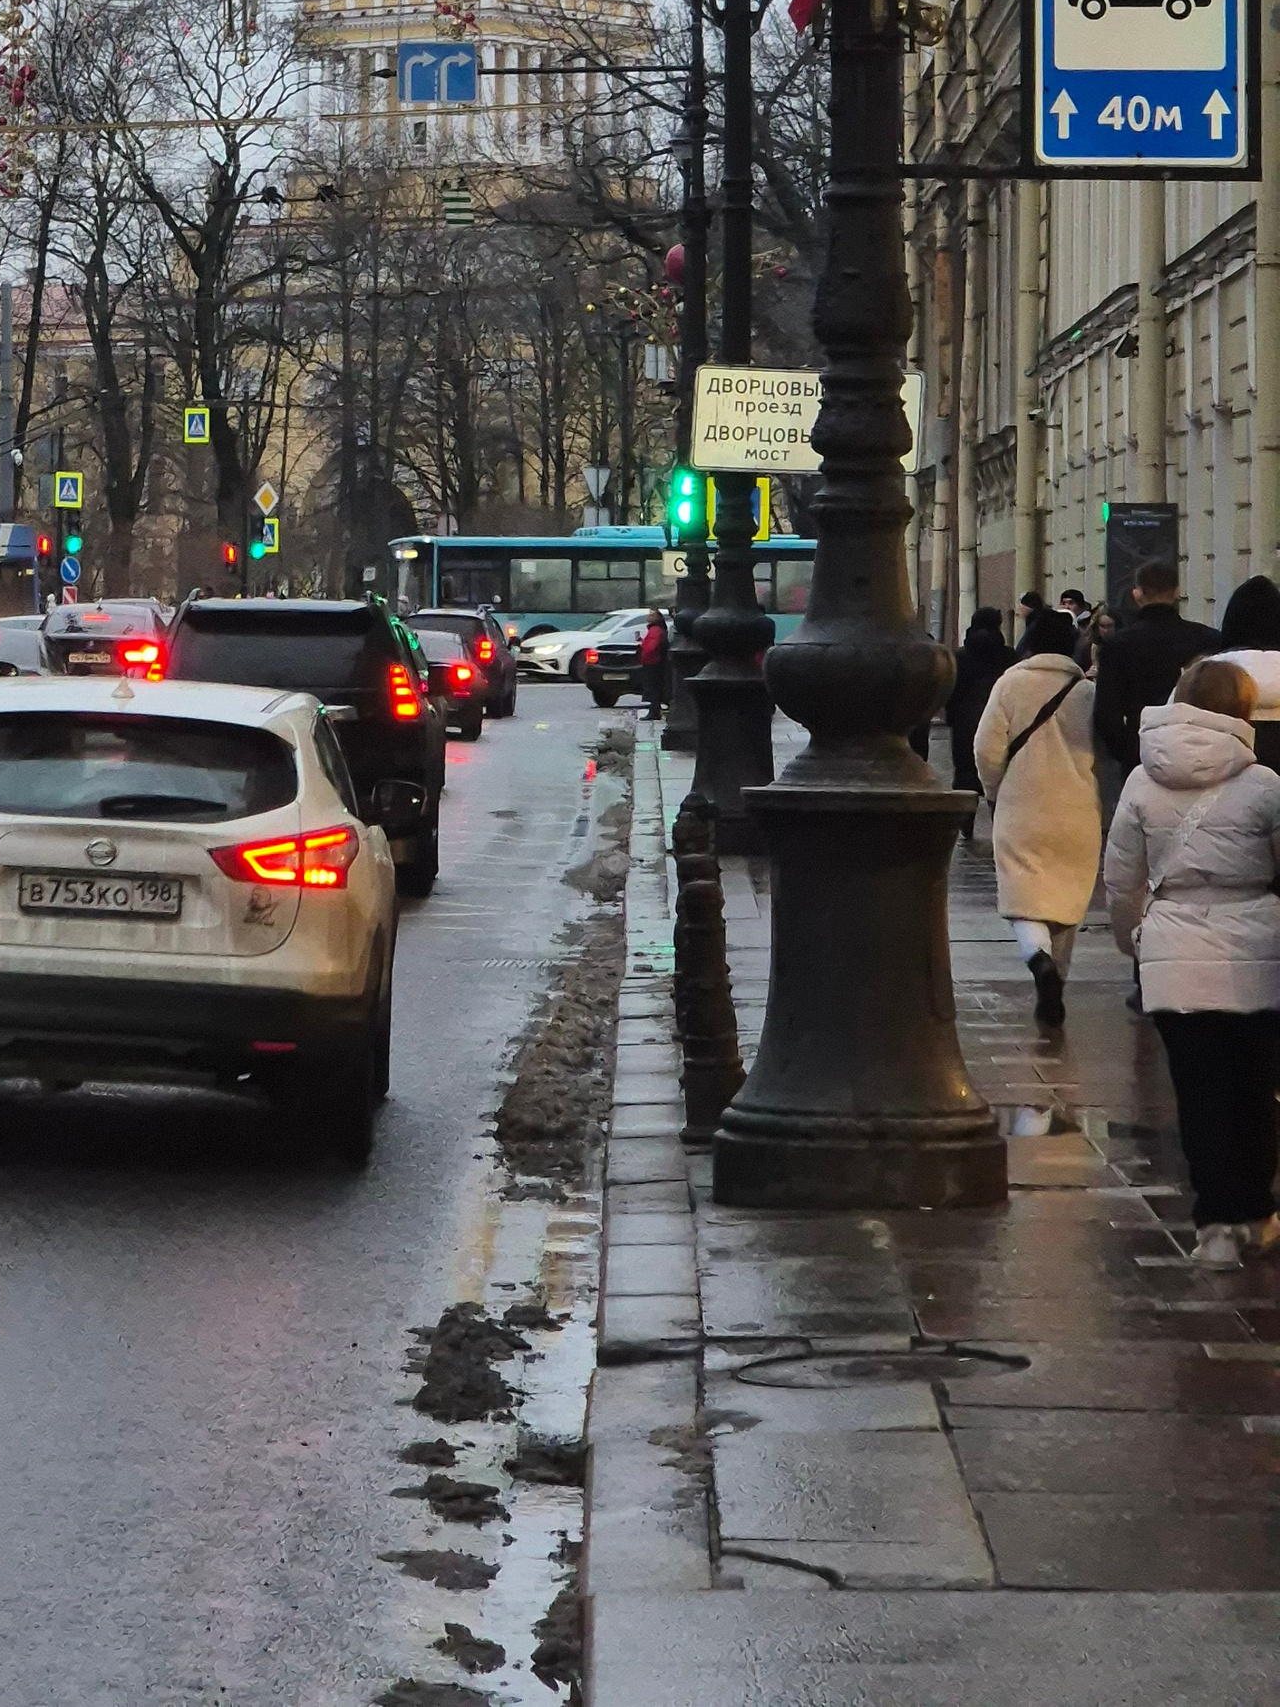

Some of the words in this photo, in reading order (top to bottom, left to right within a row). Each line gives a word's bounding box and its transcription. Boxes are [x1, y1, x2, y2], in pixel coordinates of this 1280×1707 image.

[706, 377, 825, 397] ДВОРЦОВЫ
[734, 399, 803, 417] проезд
[703, 424, 813, 445] ДВОРЦОВ
[744, 448, 791, 462] мост
[30, 877, 130, 907] В753КО
[135, 882, 172, 902] 198
